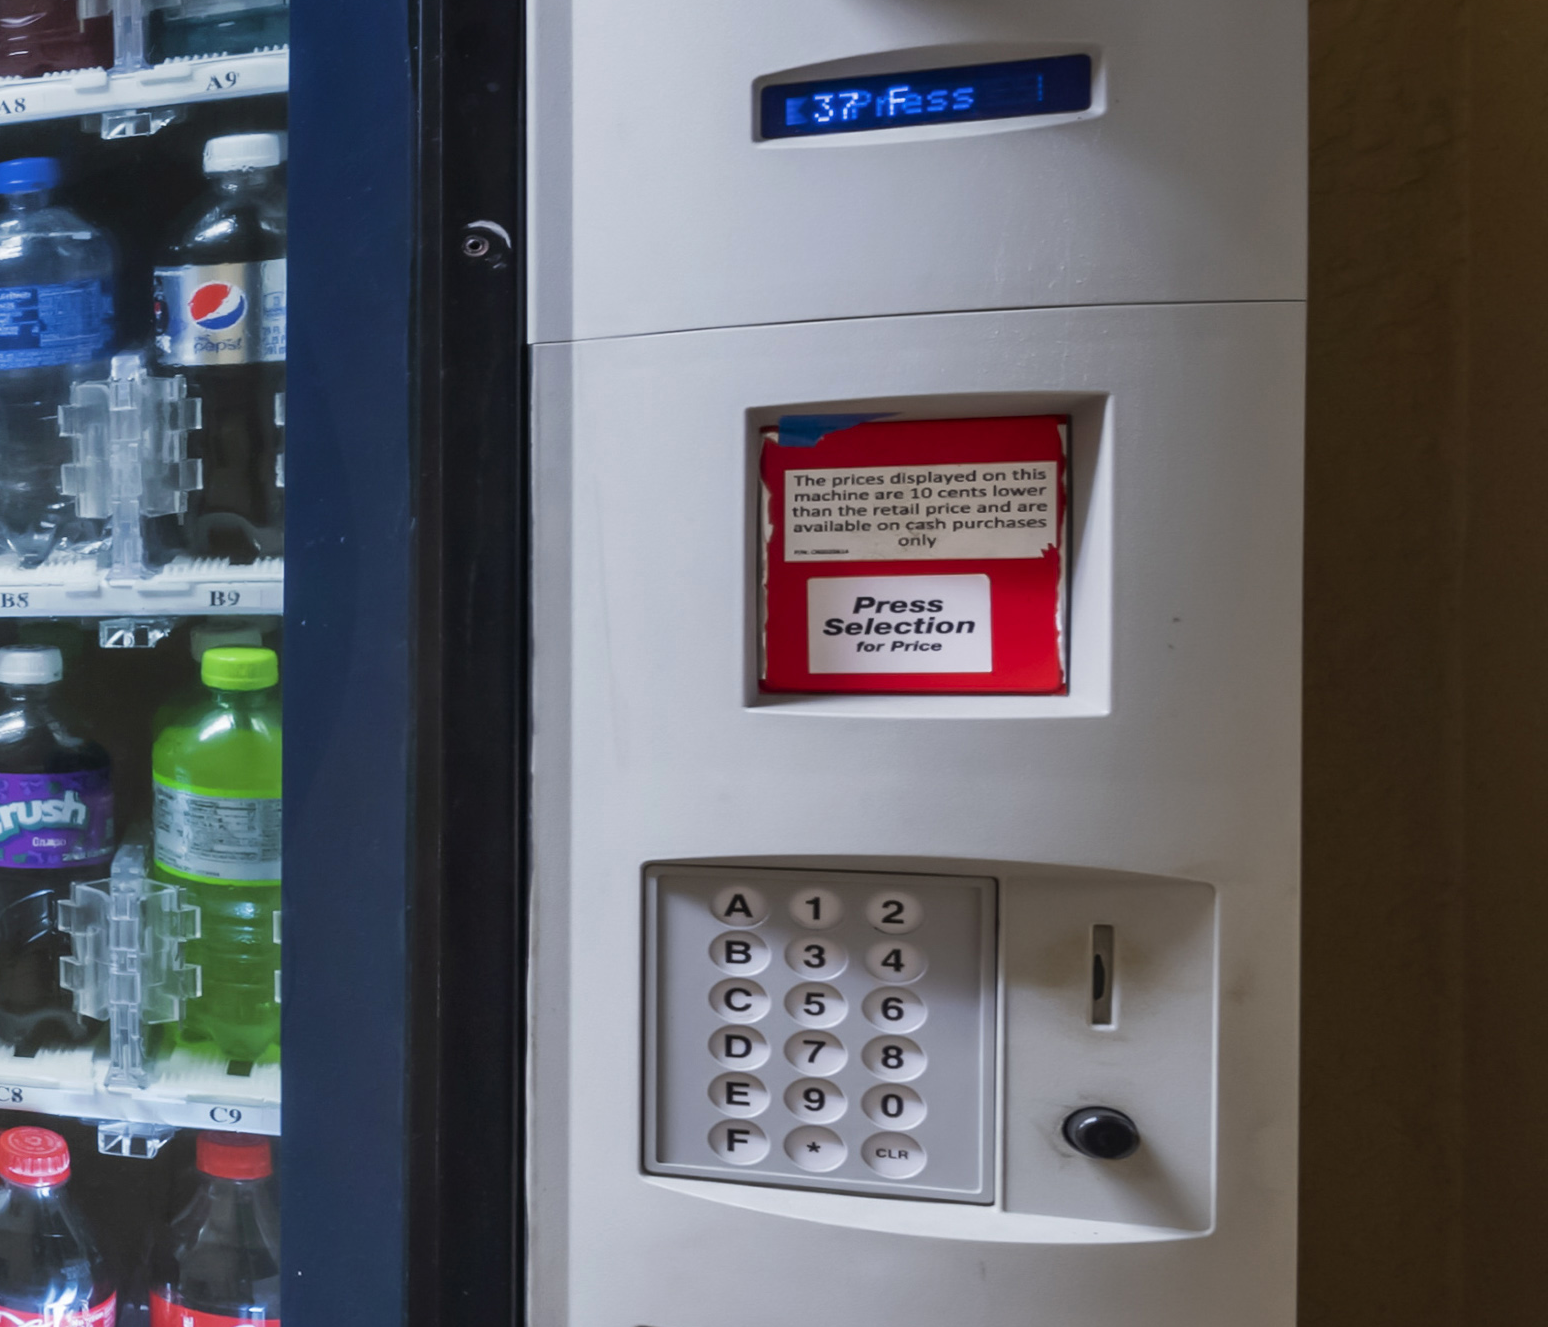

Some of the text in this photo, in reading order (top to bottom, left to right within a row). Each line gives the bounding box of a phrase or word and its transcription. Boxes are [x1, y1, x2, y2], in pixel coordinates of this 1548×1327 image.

[205, 71, 237, 92] A9
[794, 469, 1046, 489] The prices displayed on this
[794, 485, 1047, 502] machine are 10 cents lower
[792, 501, 1048, 518] than the retail price and are
[793, 517, 1047, 533] available on cash purchases
[898, 534, 937, 548] only
[209, 590, 240, 607] B9
[853, 596, 944, 614] Press
[823, 618, 975, 636] Selection
[856, 640, 943, 652] for Price
[724, 893, 905, 924] A 1 2
[724, 941, 906, 972] B 3 4
[723, 988, 905, 1021] C 5 6
[724, 1035, 905, 1070] D 7 8
[724, 1083, 904, 1118] E 9 0
[725, 1130, 910, 1161] F CLR
